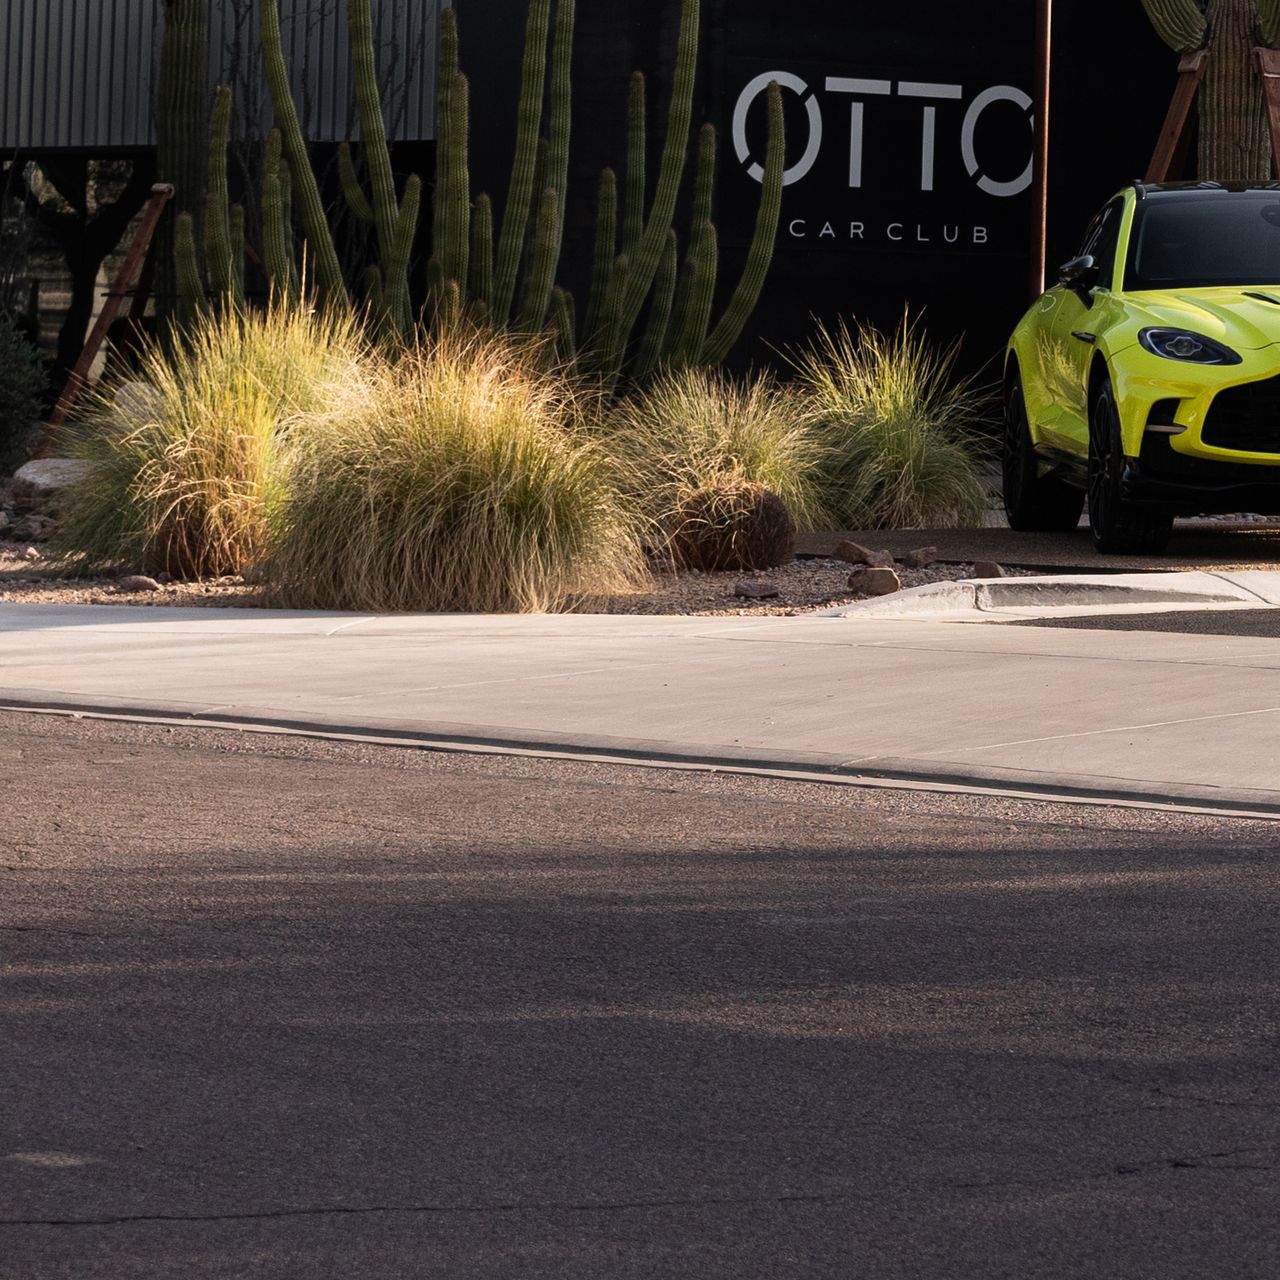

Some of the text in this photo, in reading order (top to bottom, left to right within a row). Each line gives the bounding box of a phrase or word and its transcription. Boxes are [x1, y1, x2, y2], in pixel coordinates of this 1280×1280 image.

[732, 69, 1034, 196] OTTO
[789, 219, 989, 243] CAR CLUB
